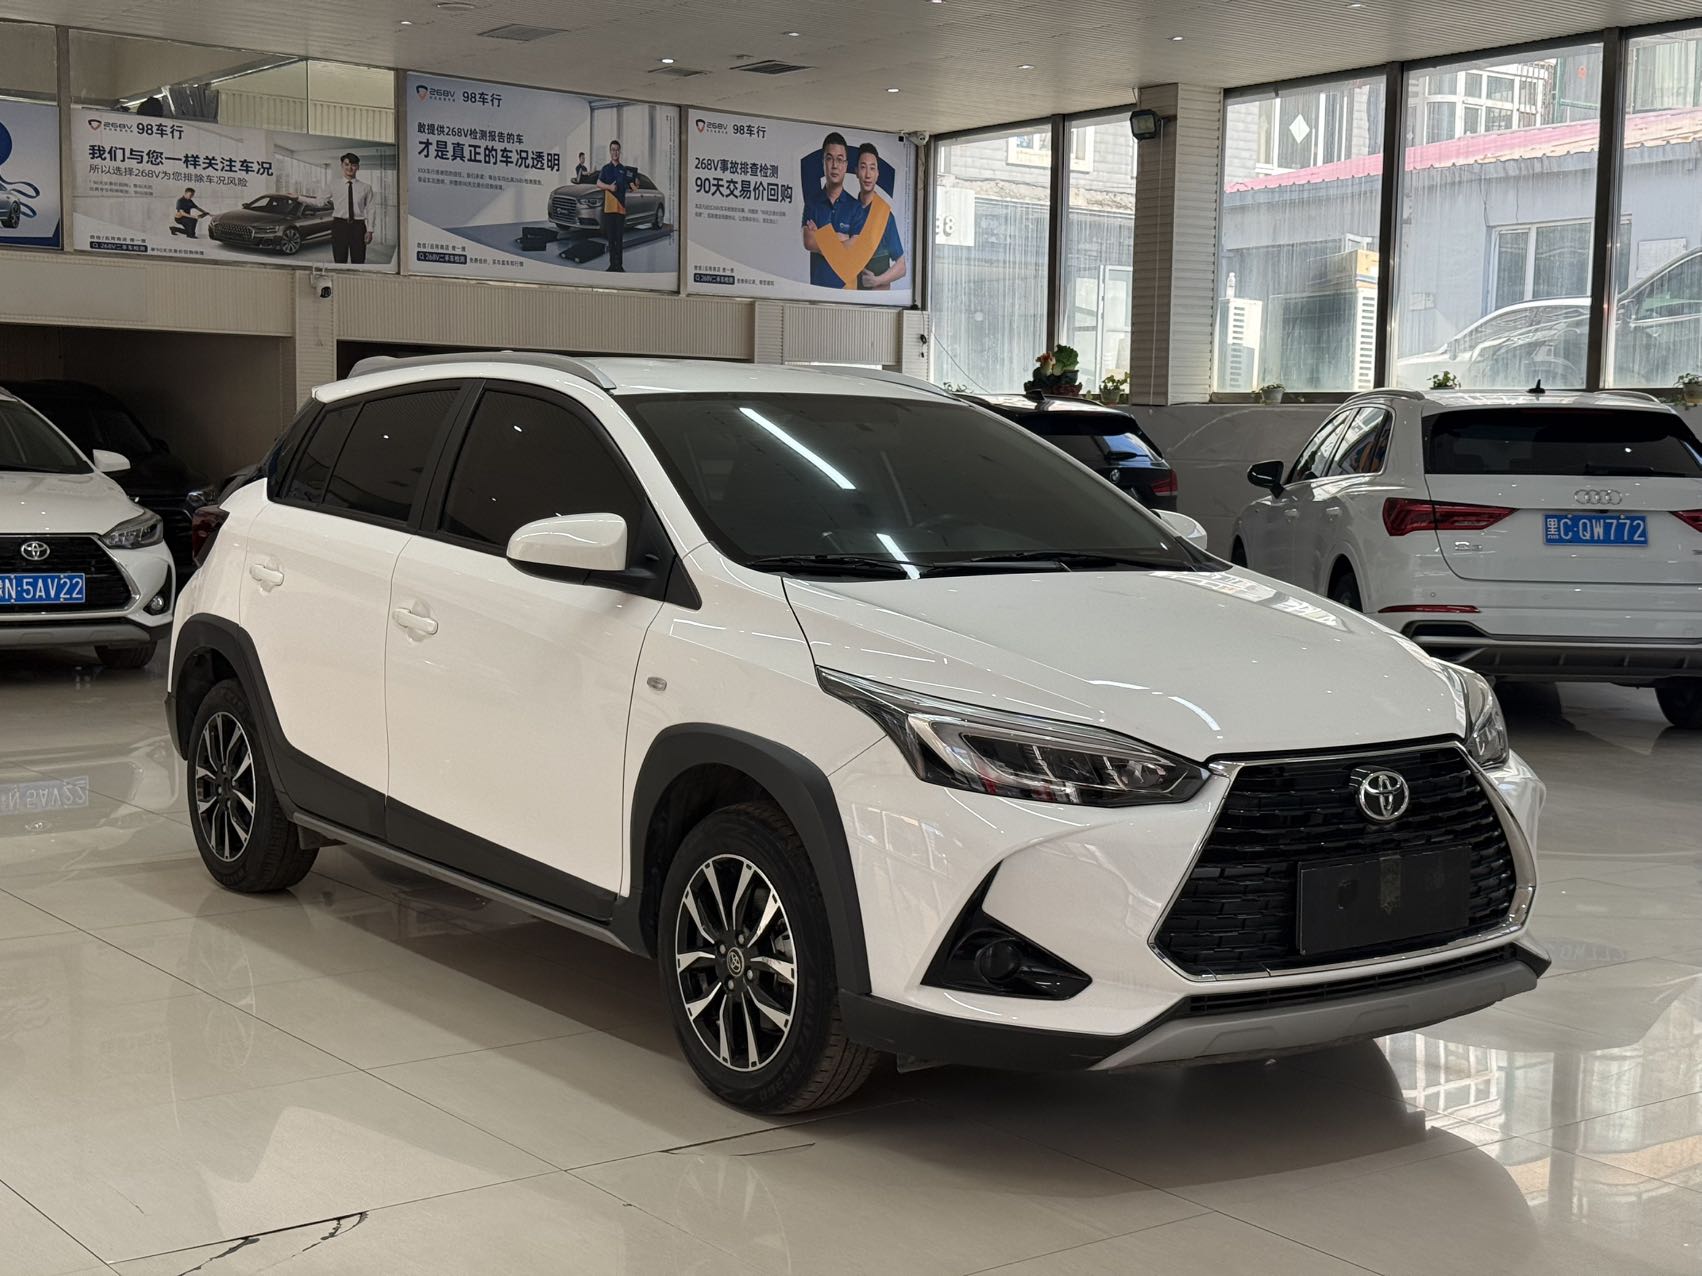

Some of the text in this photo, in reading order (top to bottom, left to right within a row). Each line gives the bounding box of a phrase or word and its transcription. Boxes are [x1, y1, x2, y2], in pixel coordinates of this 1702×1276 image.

[429, 88, 456, 98] 268V
[462, 91, 503, 108] 98车行
[136, 122, 185, 140] 98车行
[417, 121, 524, 145] 敢提供268V检测报告的车
[732, 124, 767, 139] 98车行
[88, 144, 274, 177] 我们与您一样关注车况
[418, 138, 561, 172] 才是真正的车况透明
[88, 163, 249, 188] 所以选择268V为您排除车况风险
[694, 157, 779, 179] 268V事故排查检测
[695, 176, 793, 204] 90天交易价回购
[1546, 518, 1646, 541] 黑C·QW772
